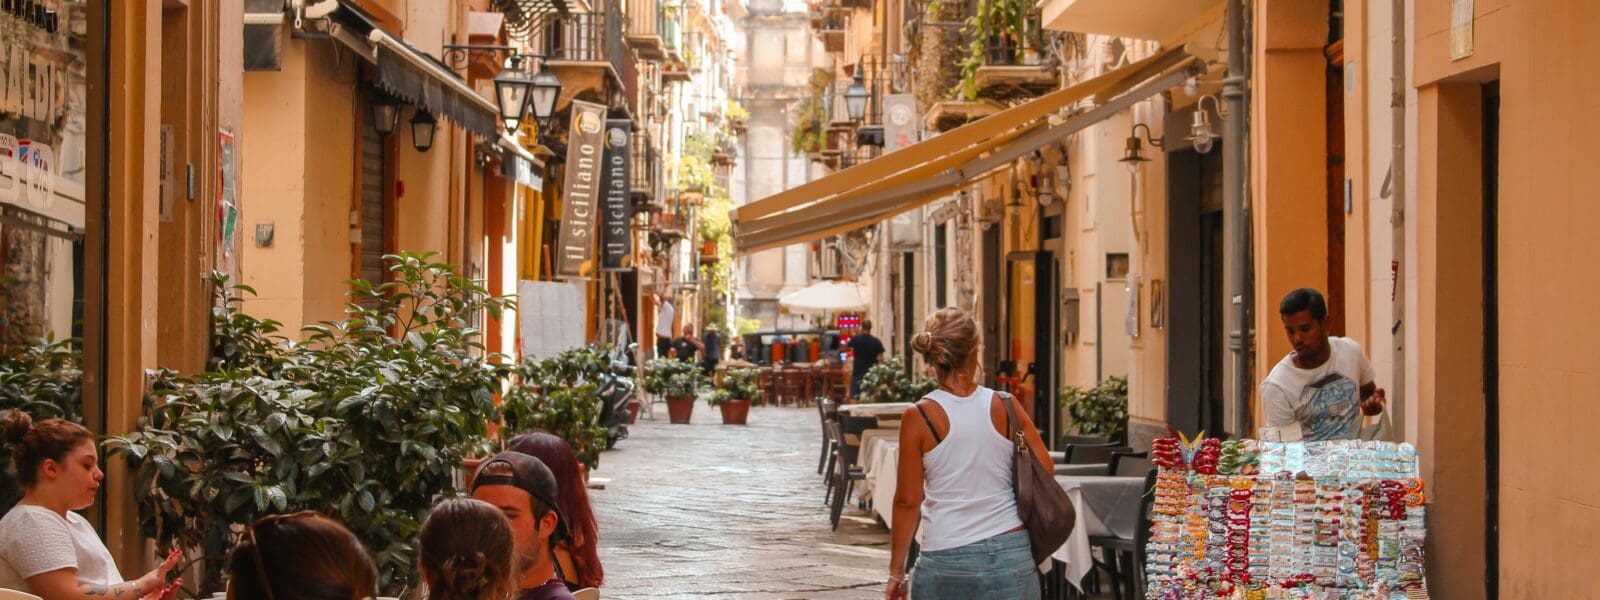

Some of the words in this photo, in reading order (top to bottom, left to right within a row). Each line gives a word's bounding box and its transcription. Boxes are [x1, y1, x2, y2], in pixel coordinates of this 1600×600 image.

[0, 41, 56, 125] ALDI
[570, 144, 595, 238] siciliano
[607, 156, 624, 235] siciliano
[565, 245, 585, 259] il
[607, 243, 624, 254] il
